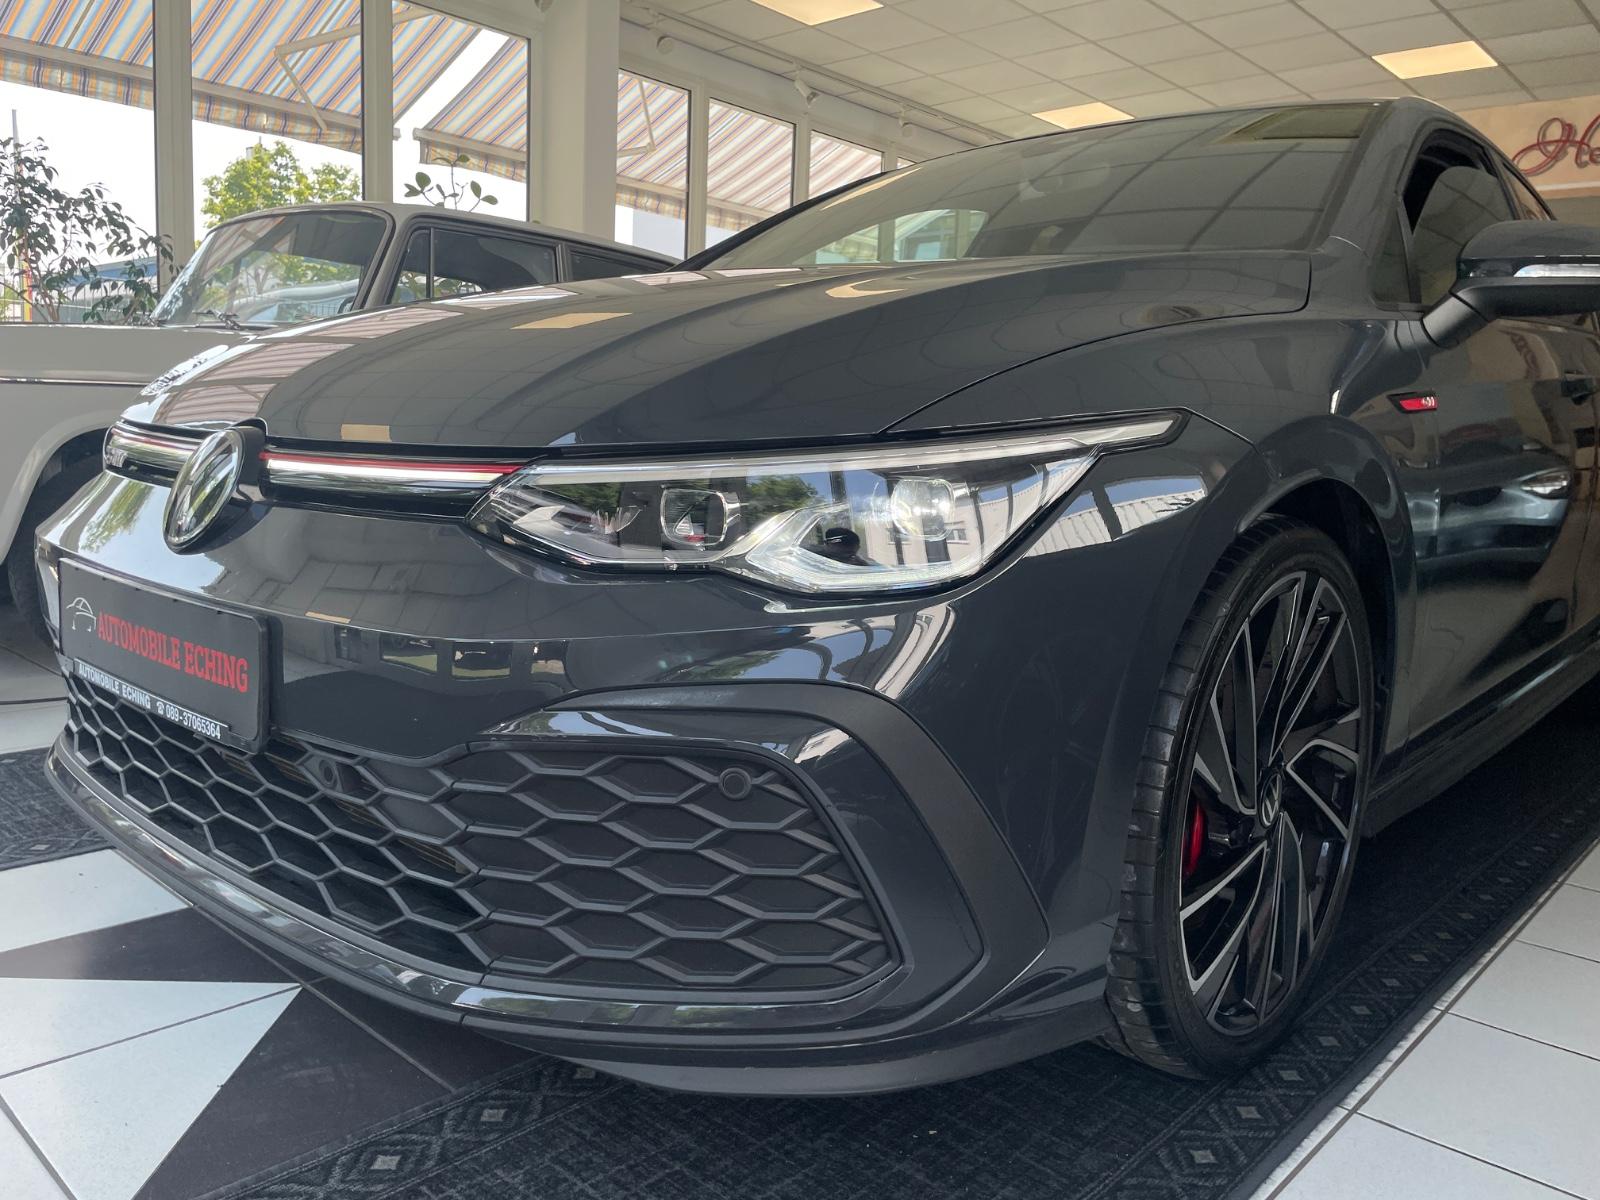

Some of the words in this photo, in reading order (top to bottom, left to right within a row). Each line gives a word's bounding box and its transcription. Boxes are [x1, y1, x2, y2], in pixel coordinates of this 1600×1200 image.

[98, 611, 181, 670] AUTOMOBILE
[184, 641, 248, 693] ECHING
[79, 663, 120, 695] AUTOMOBILE
[122, 684, 151, 709] ECHING
[165, 704, 221, 740] 089-37065364
